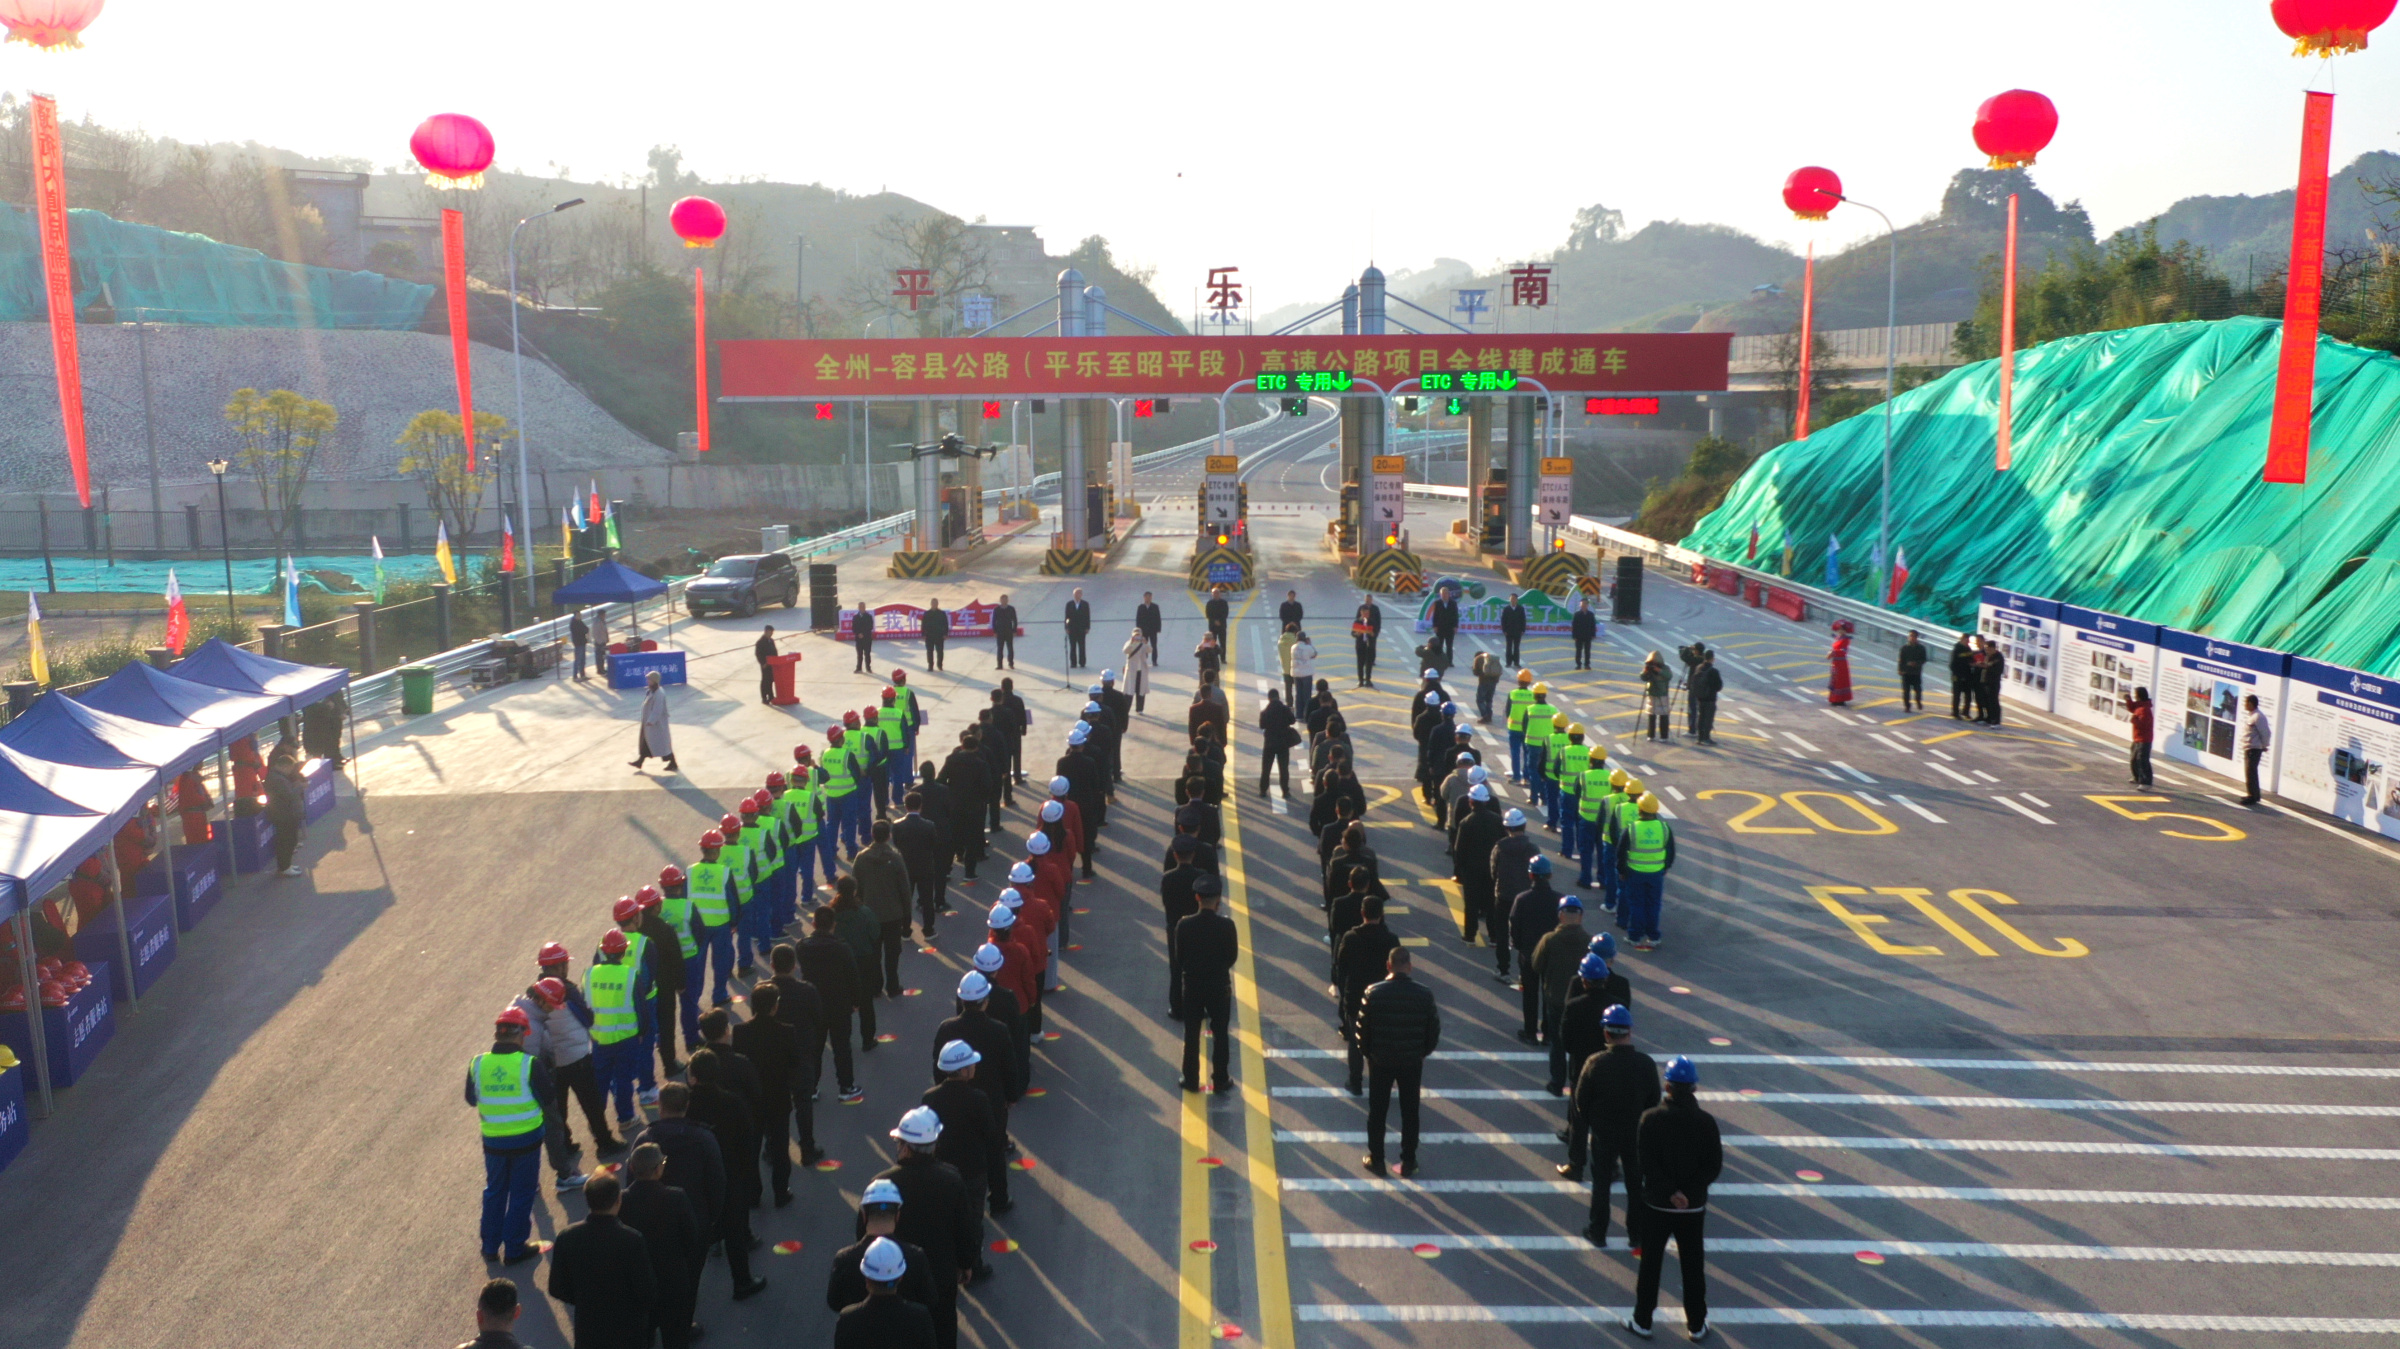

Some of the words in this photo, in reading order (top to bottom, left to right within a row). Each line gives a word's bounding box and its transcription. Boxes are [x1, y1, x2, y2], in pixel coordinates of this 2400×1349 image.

[892, 270, 934, 310] 平
[1206, 266, 1243, 307] 乐
[1510, 264, 1551, 306] 南
[1257, 374, 1287, 391] ETC
[1295, 372, 1332, 391] 专用
[1421, 374, 1451, 390] ETC
[1460, 371, 1497, 390] 专用
[1696, 789, 1899, 835] 20
[2082, 795, 2247, 841] 5
[1802, 886, 2090, 958] ETC
[73, 995, 109, 1048] 志愿者服务站
